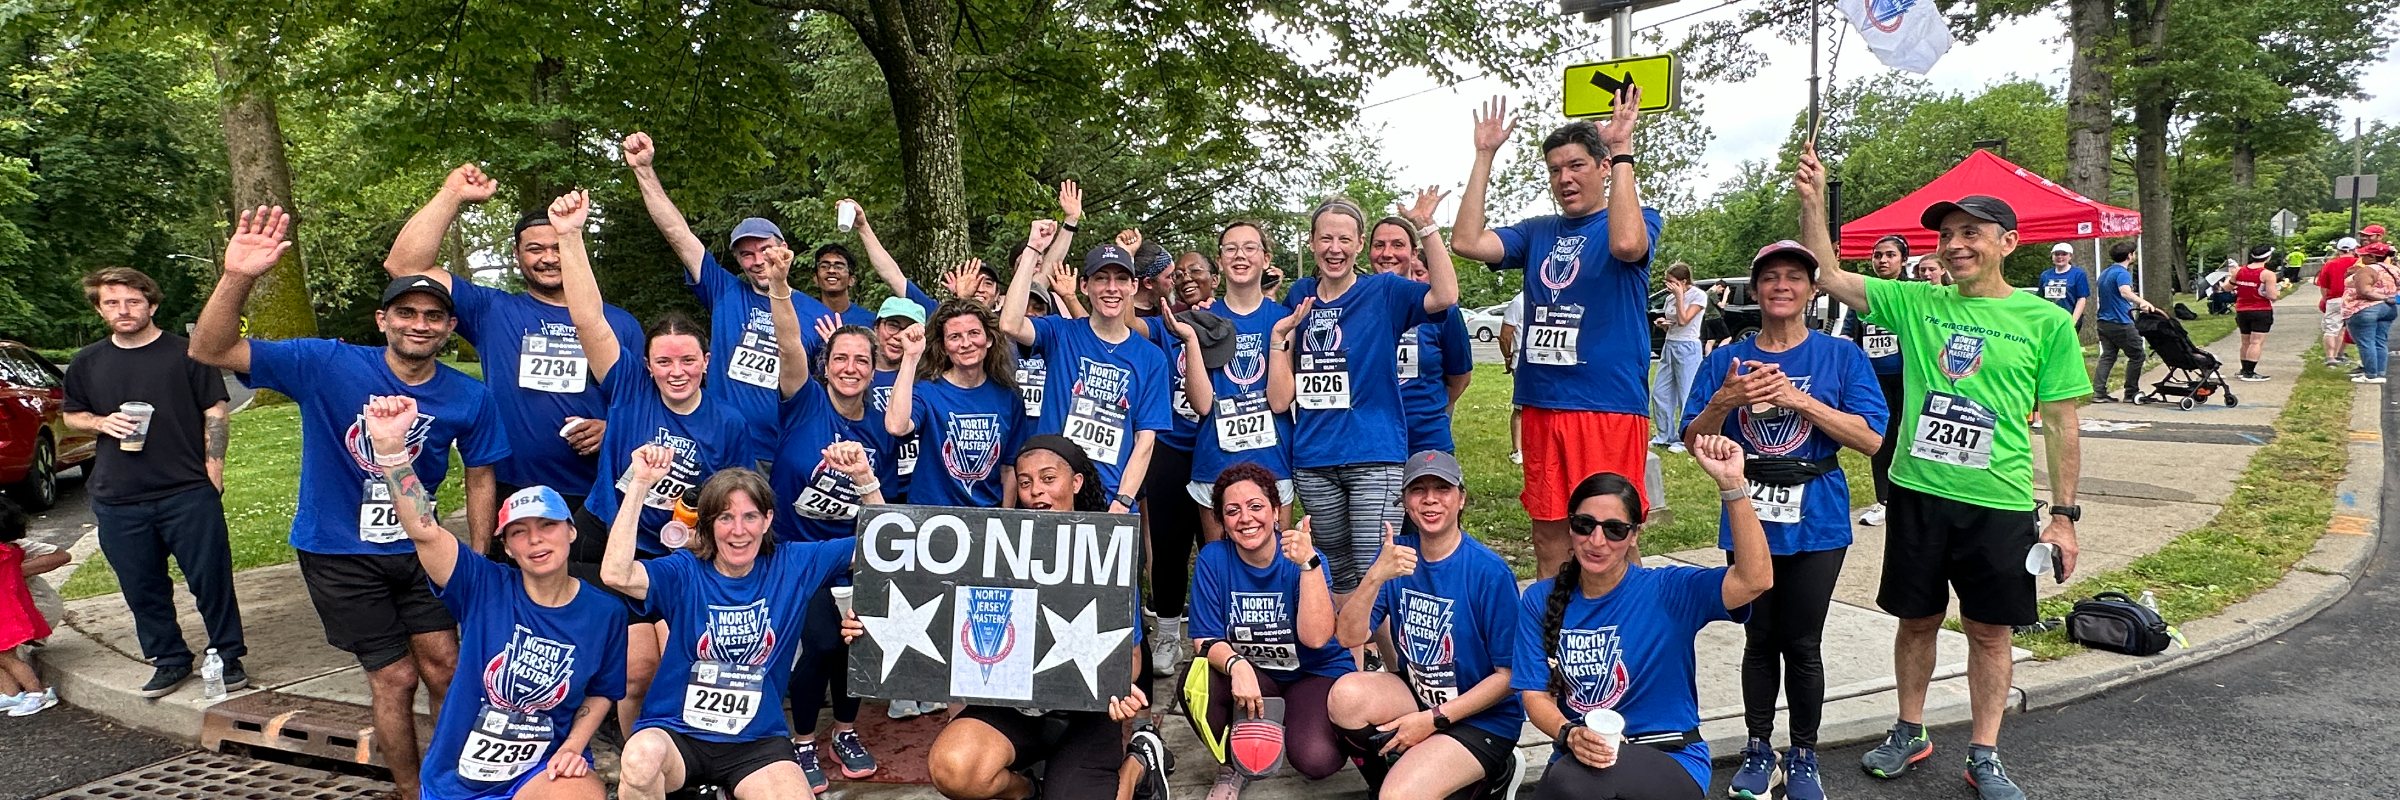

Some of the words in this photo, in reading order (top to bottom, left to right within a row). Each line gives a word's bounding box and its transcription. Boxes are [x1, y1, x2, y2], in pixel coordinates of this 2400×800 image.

[1534, 328, 1568, 349] 2211
[1925, 315, 1940, 325] THE
[2003, 333, 2027, 345] RUN
[1869, 337, 1892, 349] 2113
[1954, 335, 1978, 346] NORTH
[530, 358, 577, 377] 2734
[737, 350, 777, 374] 2228
[1089, 363, 1120, 380] NORTH
[1086, 374, 1119, 393] JERSEY
[1302, 374, 1343, 394] 2626
[1020, 388, 1042, 404] 40
[959, 418, 989, 430] NORTH
[1071, 419, 1116, 447] 2065
[1226, 414, 1265, 438] 2627
[958, 429, 990, 441] JERSEY
[1925, 420, 1982, 450] 2347
[956, 440, 991, 452] MASTERS
[651, 478, 686, 500] 89
[1750, 480, 1790, 504] 215
[510, 495, 544, 510] USA
[805, 493, 849, 517] 2431
[371, 506, 399, 526] 26
[862, 512, 971, 575] GO
[982, 517, 1134, 587] NJM
[975, 589, 1007, 601] NORTH
[1242, 597, 1275, 610] NORTH
[976, 601, 1005, 613] JERSEY
[1408, 596, 1440, 616] NORTH
[718, 609, 756, 625] NORTH
[973, 613, 1006, 624] MASTERS
[1241, 610, 1276, 623] JERSEY
[1405, 609, 1440, 630] JERSEY
[719, 619, 758, 636] JERSEY
[1253, 628, 1292, 636] RIDGEWOOD
[1403, 622, 1439, 641] MASTERS
[522, 635, 561, 661] NORTH
[715, 632, 761, 646] MASTERS
[1566, 633, 1606, 650] NORTH
[1240, 645, 1290, 659] 2259
[1565, 647, 1605, 664] JERSEY
[517, 649, 559, 675] JERSEY
[1564, 662, 1608, 678] MASTERS
[508, 660, 556, 689] MASTERS
[1413, 674, 1448, 705] 216
[694, 689, 751, 716] 2294
[472, 738, 538, 764] 2239
